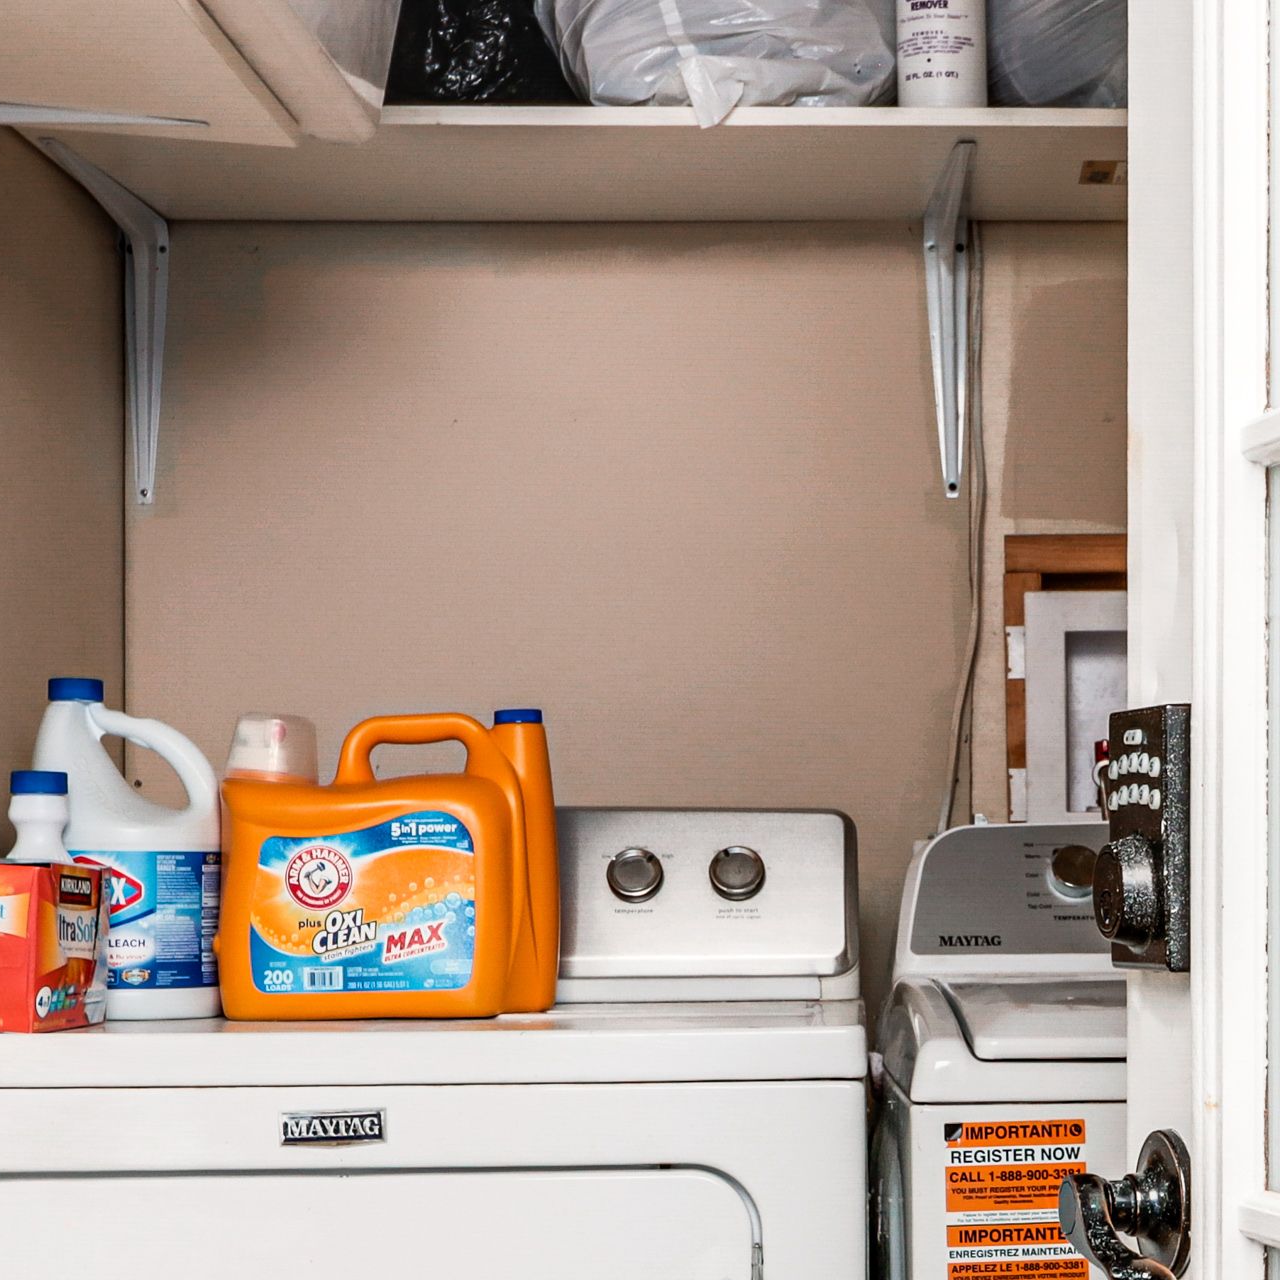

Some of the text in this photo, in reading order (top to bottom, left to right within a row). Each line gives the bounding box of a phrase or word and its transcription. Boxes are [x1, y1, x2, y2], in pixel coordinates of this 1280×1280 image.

[911, 0, 948, 10] REMOVER
[418, 824, 458, 835] power
[298, 918, 322, 930] plus
[325, 908, 363, 933] OXI
[108, 939, 146, 948] LEACH
[312, 921, 377, 954] CLEAN
[386, 922, 444, 954] MAX
[939, 935, 1002, 947] MAYTAG
[324, 944, 374, 961] stain fighters
[264, 970, 293, 985] 200
[285, 1117, 380, 1138] MAYTAG
[965, 1124, 1068, 1140] IMPORTANT!
[951, 1147, 1080, 1164] REGISTER NOW
[950, 1172, 985, 1183] CALL
[949, 1249, 1019, 1259] ENREGISTREZ
[952, 1261, 1084, 1274] APPELEZ LE 1-888-900-3381
